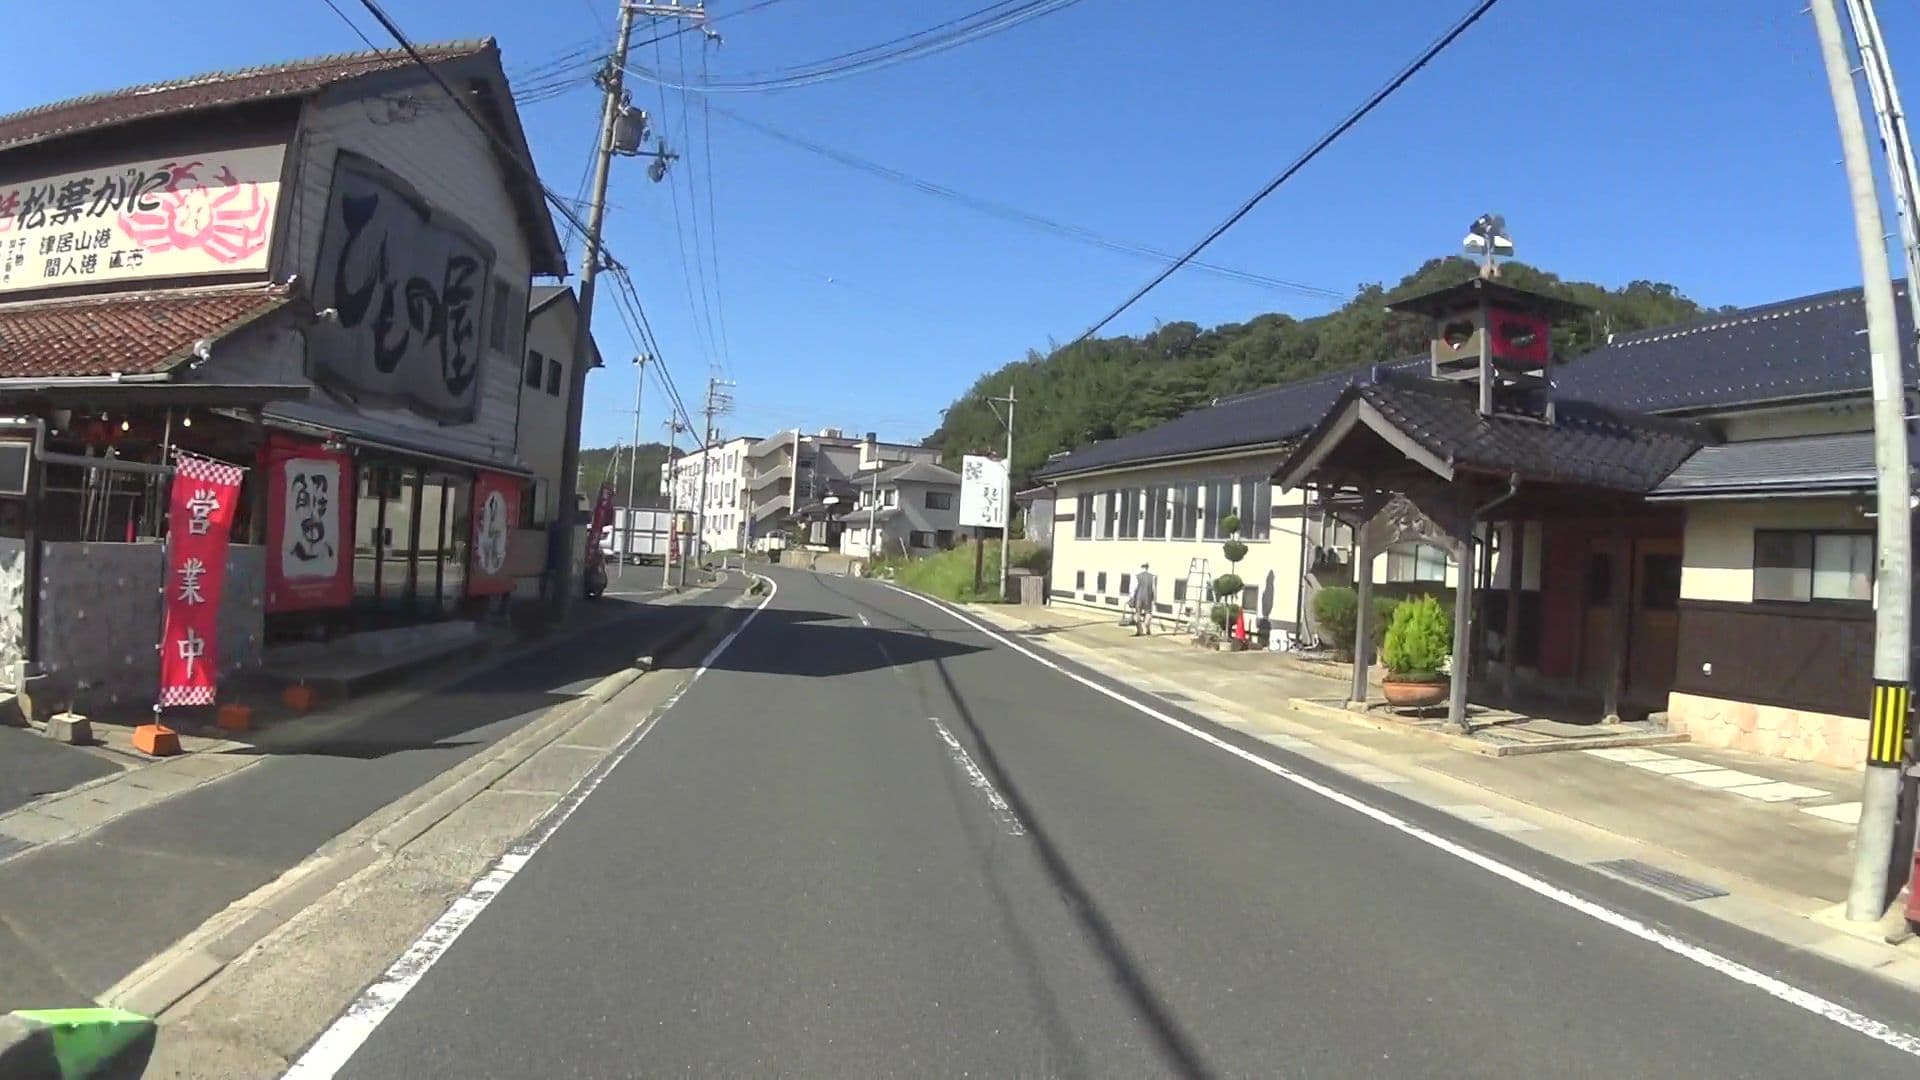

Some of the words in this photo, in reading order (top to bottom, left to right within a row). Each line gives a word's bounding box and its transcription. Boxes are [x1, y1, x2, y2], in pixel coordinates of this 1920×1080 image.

[39, 228, 111, 256] 津居山港
[43, 254, 97, 278] 間人港
[177, 488, 220, 680] 営業中
